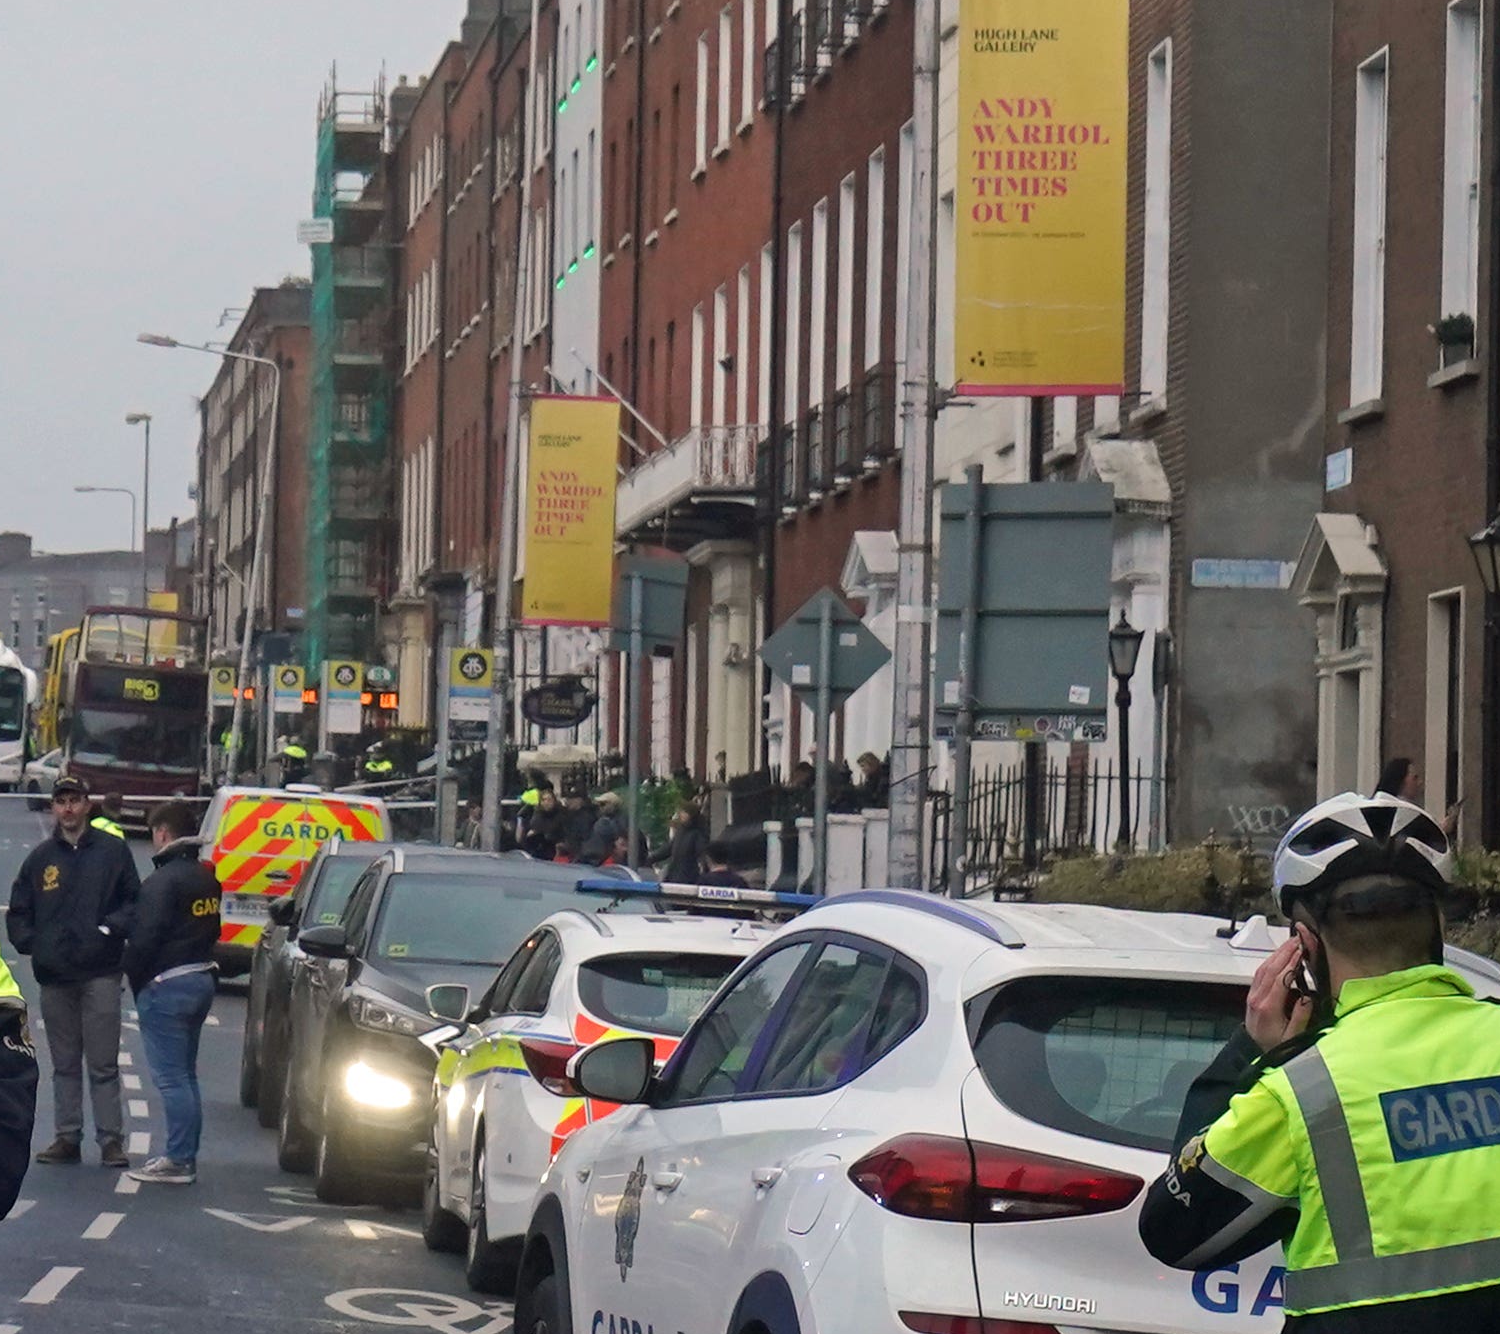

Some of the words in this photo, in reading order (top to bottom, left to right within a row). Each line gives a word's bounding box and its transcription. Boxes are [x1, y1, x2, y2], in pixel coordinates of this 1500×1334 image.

[974, 28, 1017, 41] HUGH
[1021, 28, 1058, 41] LANE
[974, 41, 1036, 53] GALLERY
[973, 97, 1057, 119] ANDY
[973, 123, 1110, 145] WARHOL
[972, 149, 1078, 171] THREE
[972, 176, 1069, 197] TIMES
[972, 202, 1036, 223] OUT
[263, 820, 345, 843] GARDA
[701, 888, 735, 898] GARDA
[1004, 1291, 1097, 1315] HYUNDAI
